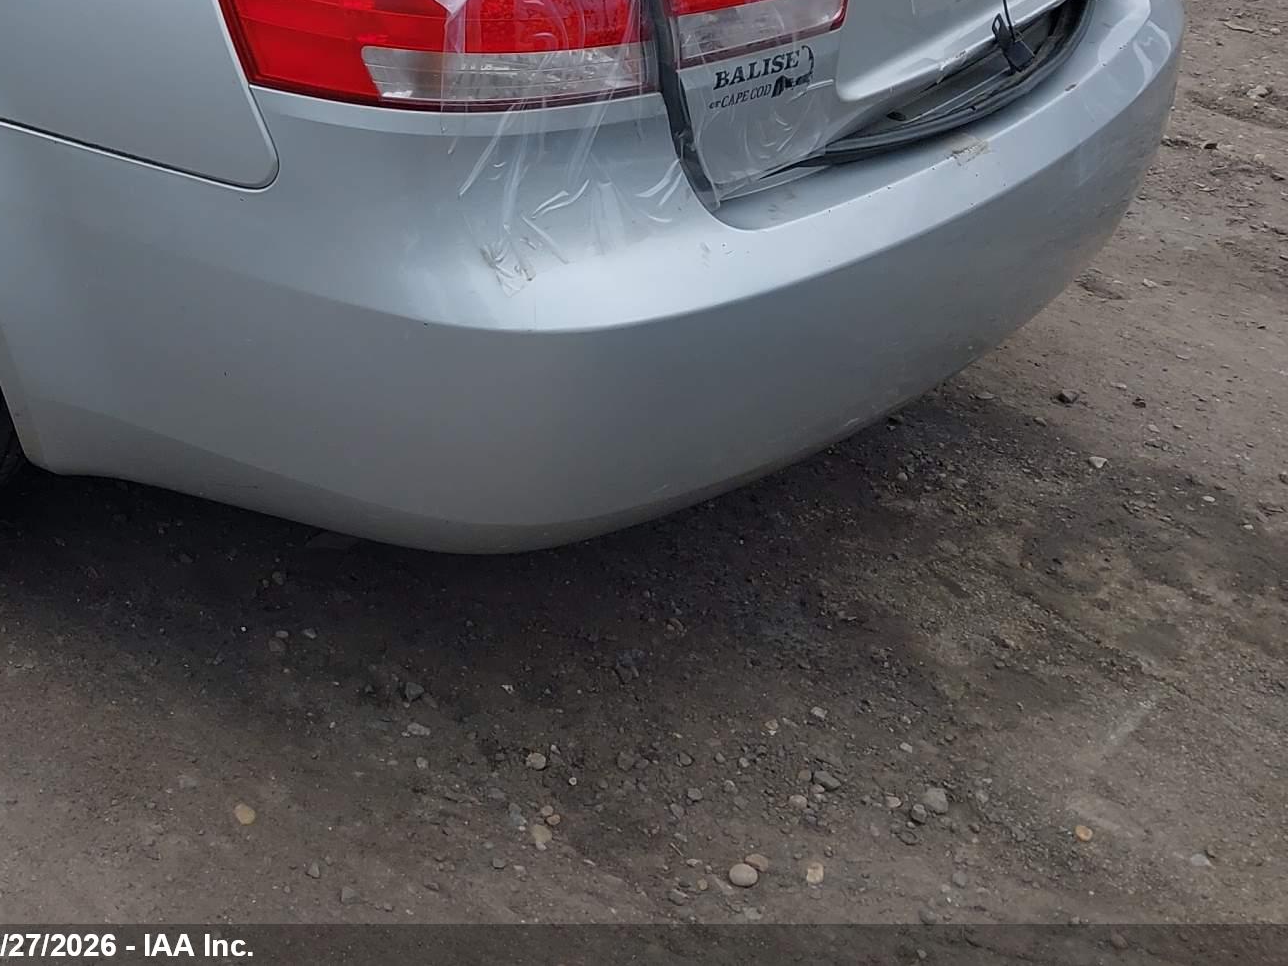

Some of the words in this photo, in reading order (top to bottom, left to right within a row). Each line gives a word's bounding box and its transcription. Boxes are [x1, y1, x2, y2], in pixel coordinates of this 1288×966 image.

[713, 50, 800, 90] BALISE
[721, 89, 750, 108] CAPE
[751, 84, 772, 100] COD
